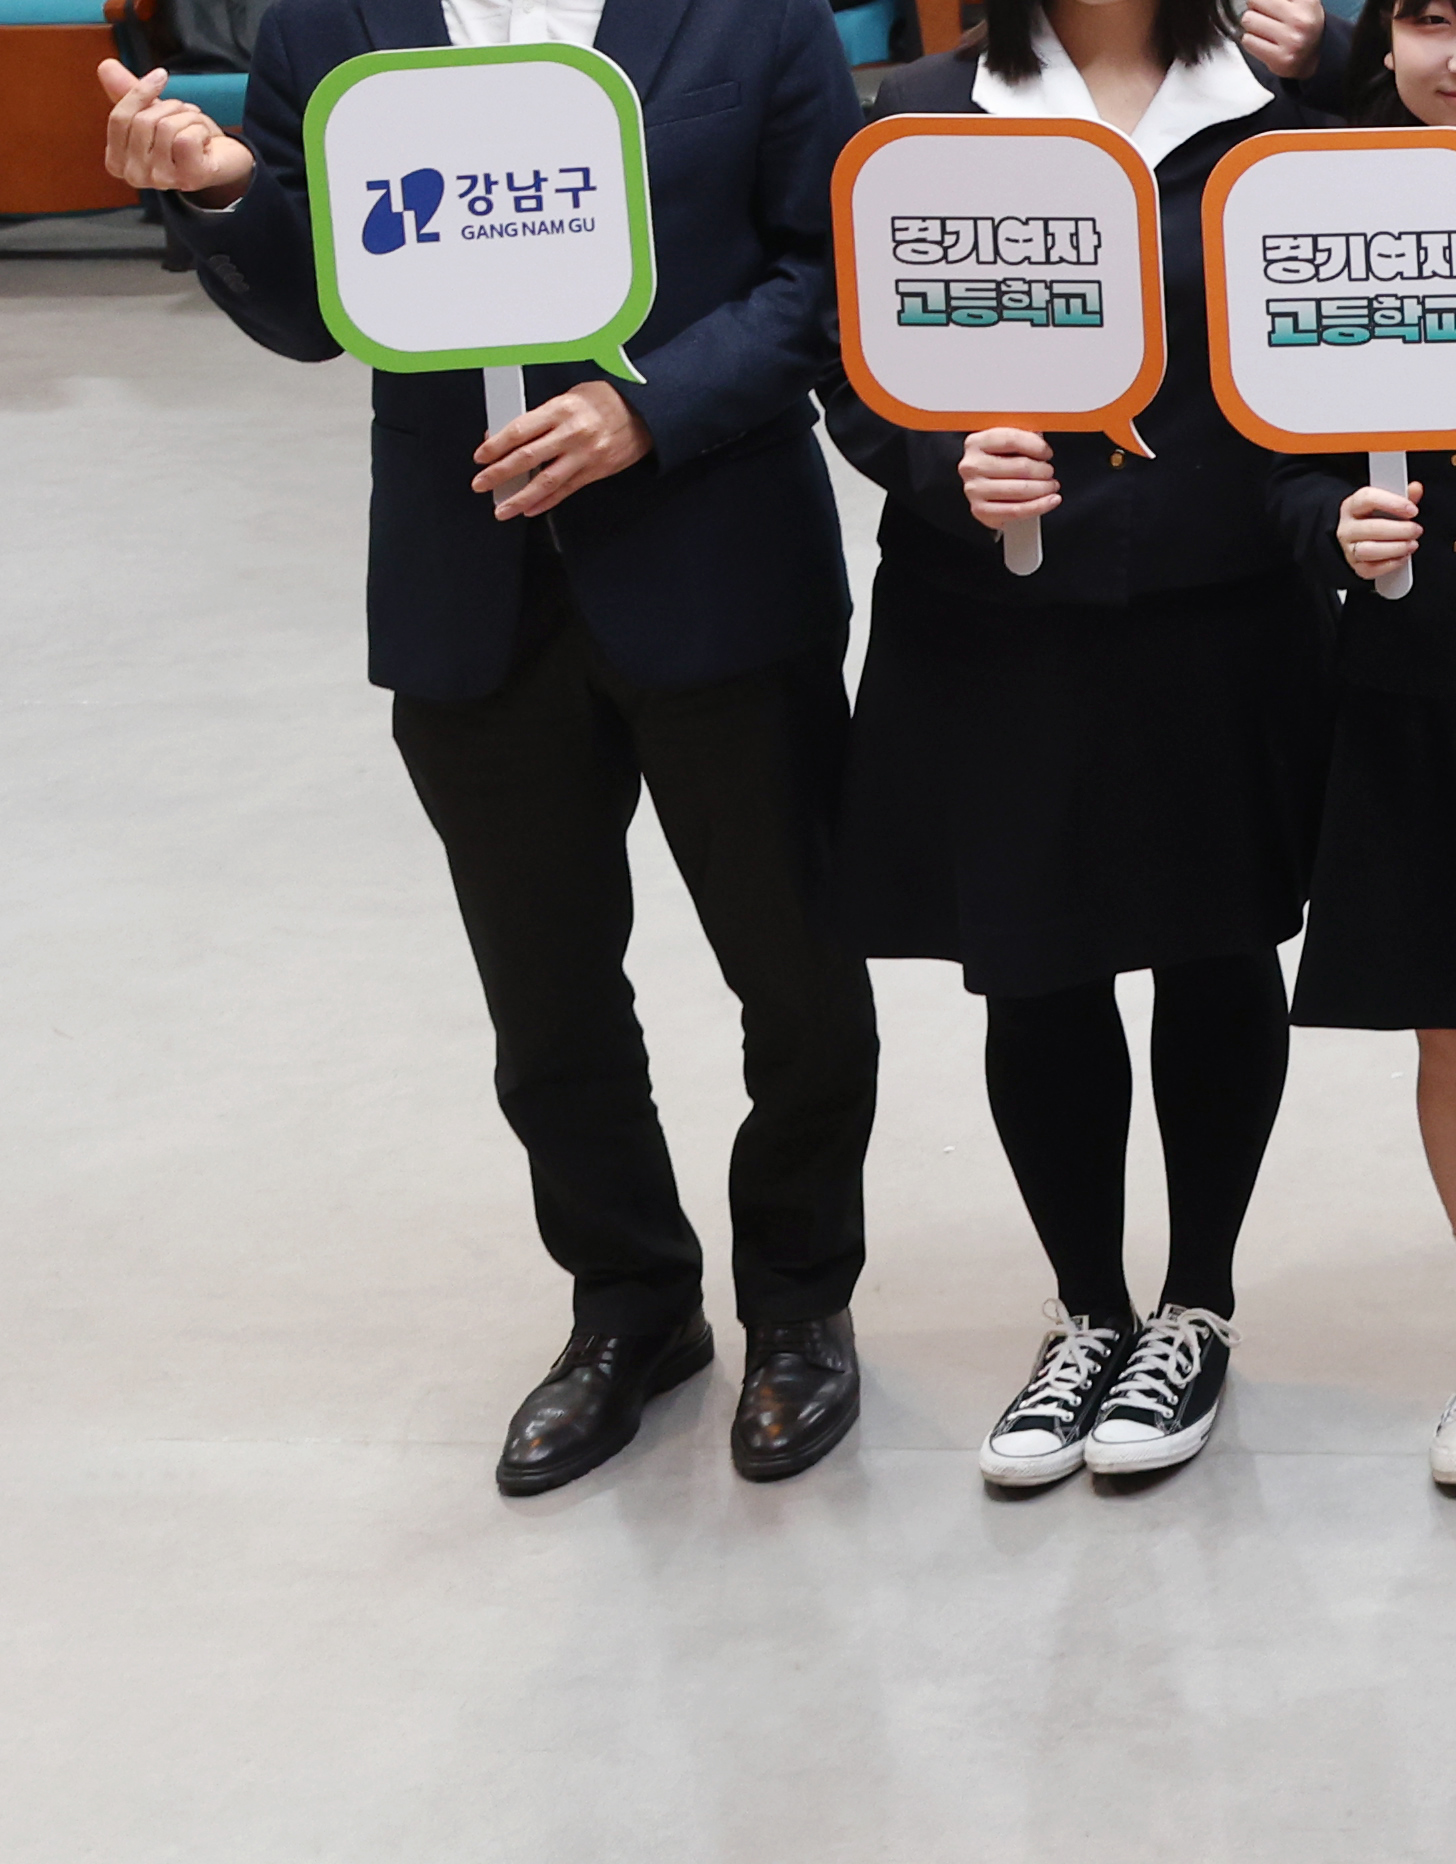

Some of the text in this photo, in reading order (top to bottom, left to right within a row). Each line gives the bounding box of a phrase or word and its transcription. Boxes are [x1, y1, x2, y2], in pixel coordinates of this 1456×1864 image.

[455, 166, 597, 216] 강남구
[461, 217, 596, 241] GANG NAM GU
[891, 216, 1102, 266] 경기여자
[895, 277, 1104, 328] 고등학교
